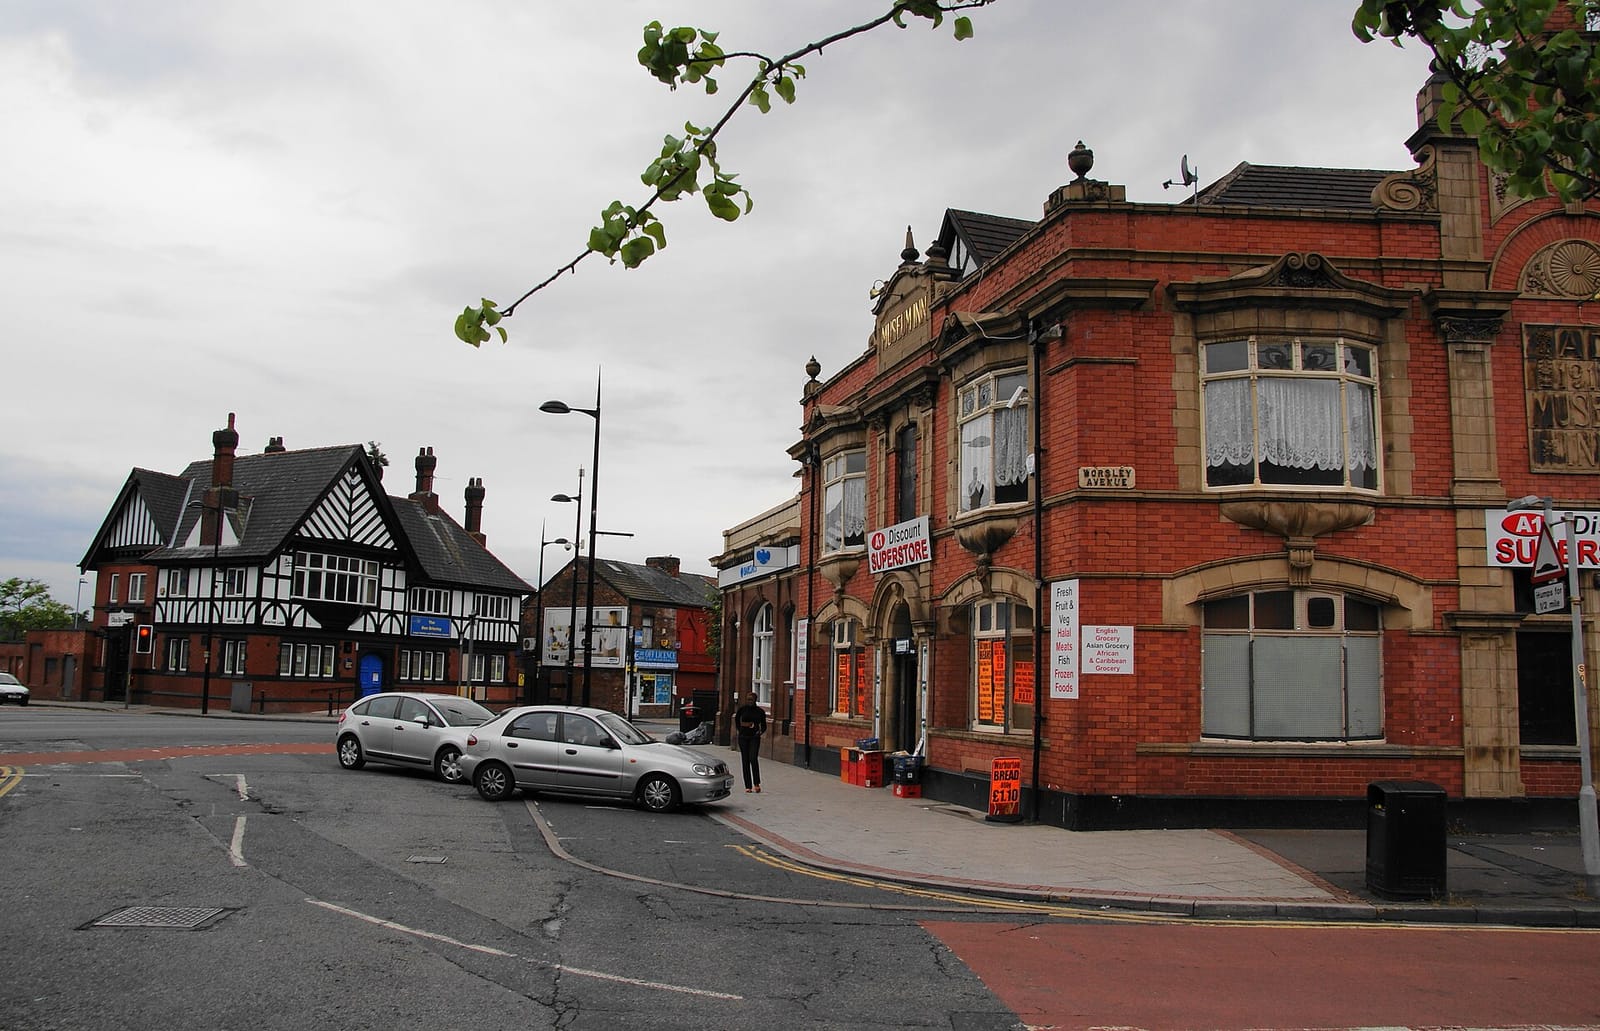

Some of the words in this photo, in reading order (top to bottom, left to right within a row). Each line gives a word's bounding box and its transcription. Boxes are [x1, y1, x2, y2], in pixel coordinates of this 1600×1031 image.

[881, 306, 912, 350] MUSEUM
[1083, 469, 1132, 478] WORSLEY
[1086, 478, 1127, 486] AVENUE
[1515, 516, 1541, 533] A1
[1574, 516, 1600, 535] Di
[889, 522, 921, 544] Discount
[871, 539, 928, 571] SUPERSTORE
[1496, 538, 1600, 565] SUER
[1057, 587, 1072, 597] Fresh
[1056, 601, 1068, 611] Fruit
[1069, 600, 1074, 610] &
[1059, 615, 1070, 626] Veg
[1057, 628, 1072, 638] Halal
[1056, 642, 1073, 652] Meats
[1058, 656, 1070, 665] Fish
[1055, 669, 1073, 678] Frozen
[1055, 683, 1073, 693] Foods
[993, 770, 1019, 781] BREAD
[992, 789, 1018, 802] £1.10
